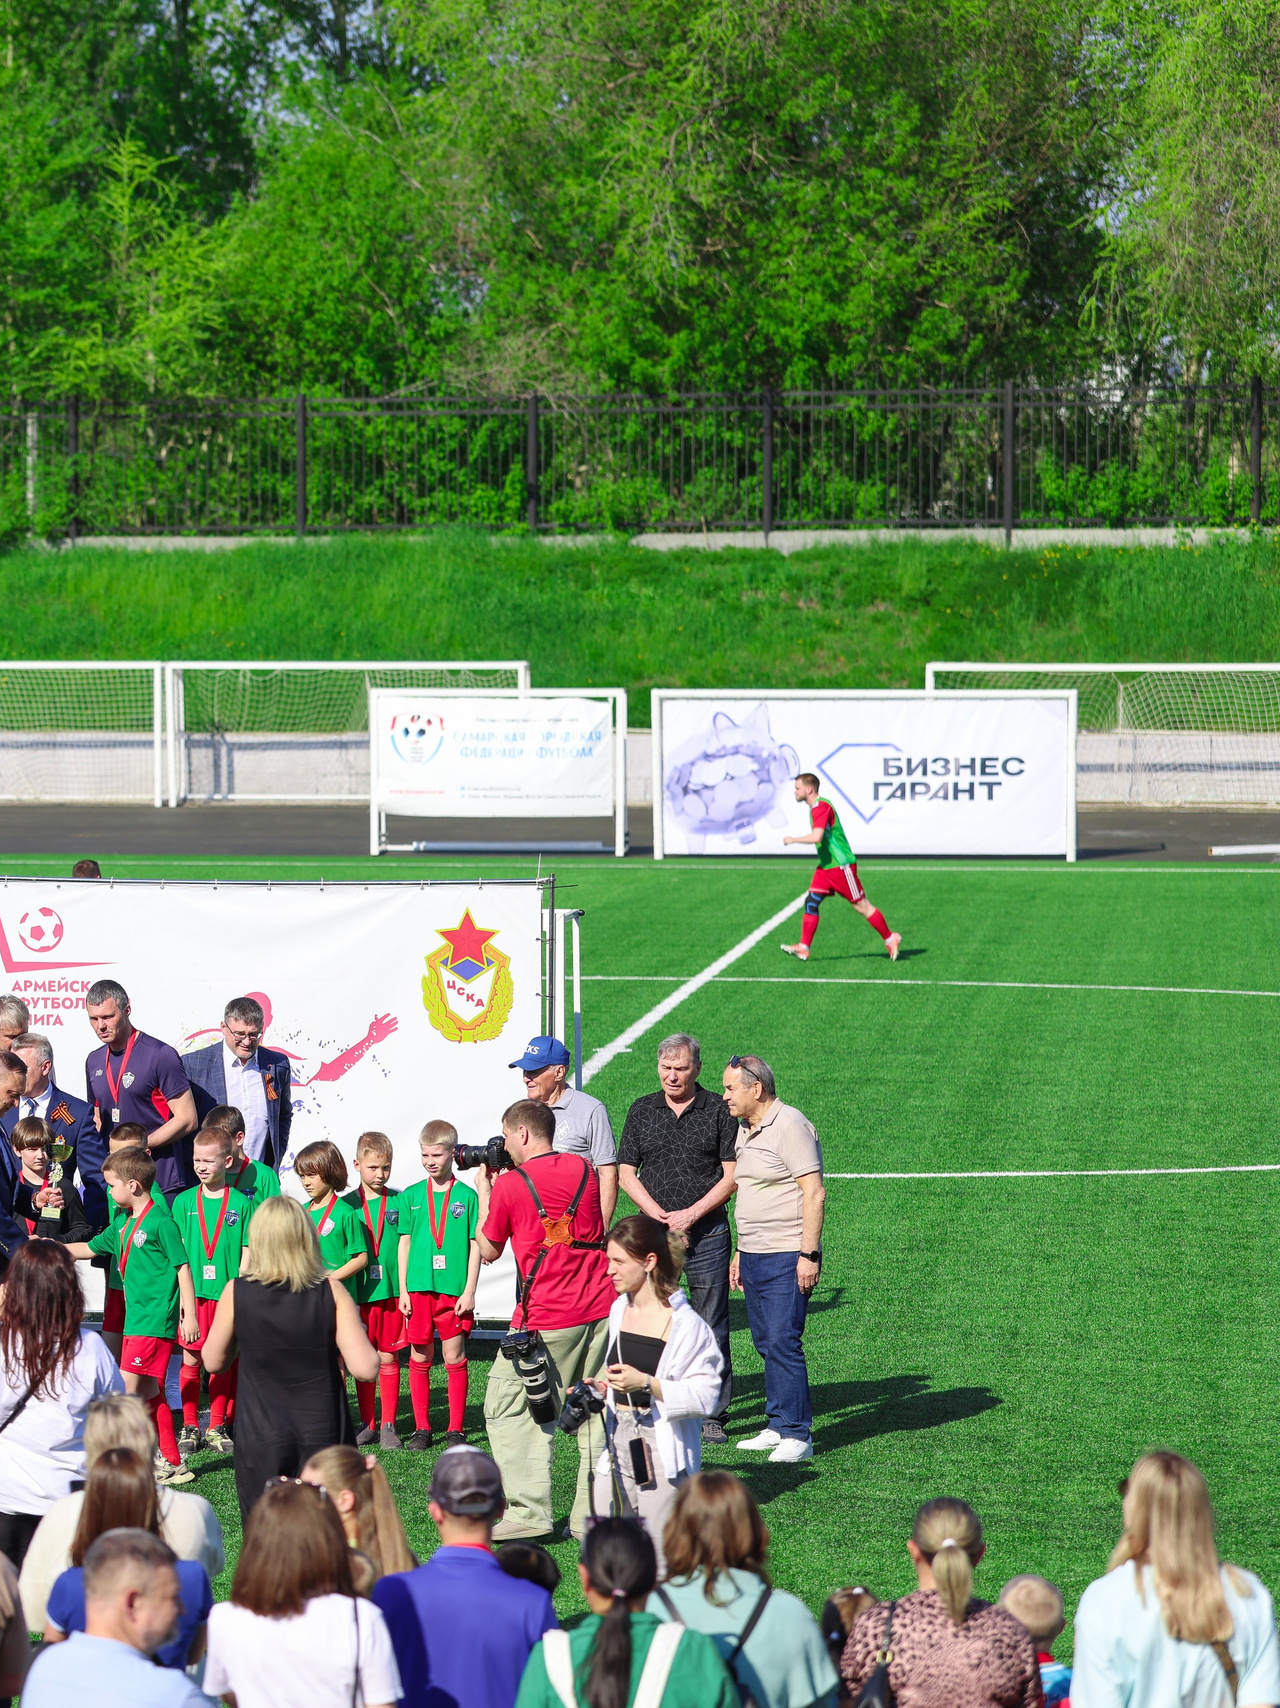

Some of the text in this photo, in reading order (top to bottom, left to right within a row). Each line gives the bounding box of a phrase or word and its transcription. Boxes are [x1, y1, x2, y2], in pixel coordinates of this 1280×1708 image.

[459, 746, 529, 760] ФЕДЕРАЦИ
[883, 757, 1025, 776] БИЗНЕС
[873, 781, 1002, 801] ГАРАНТ
[446, 980, 485, 1008] ЦСКА
